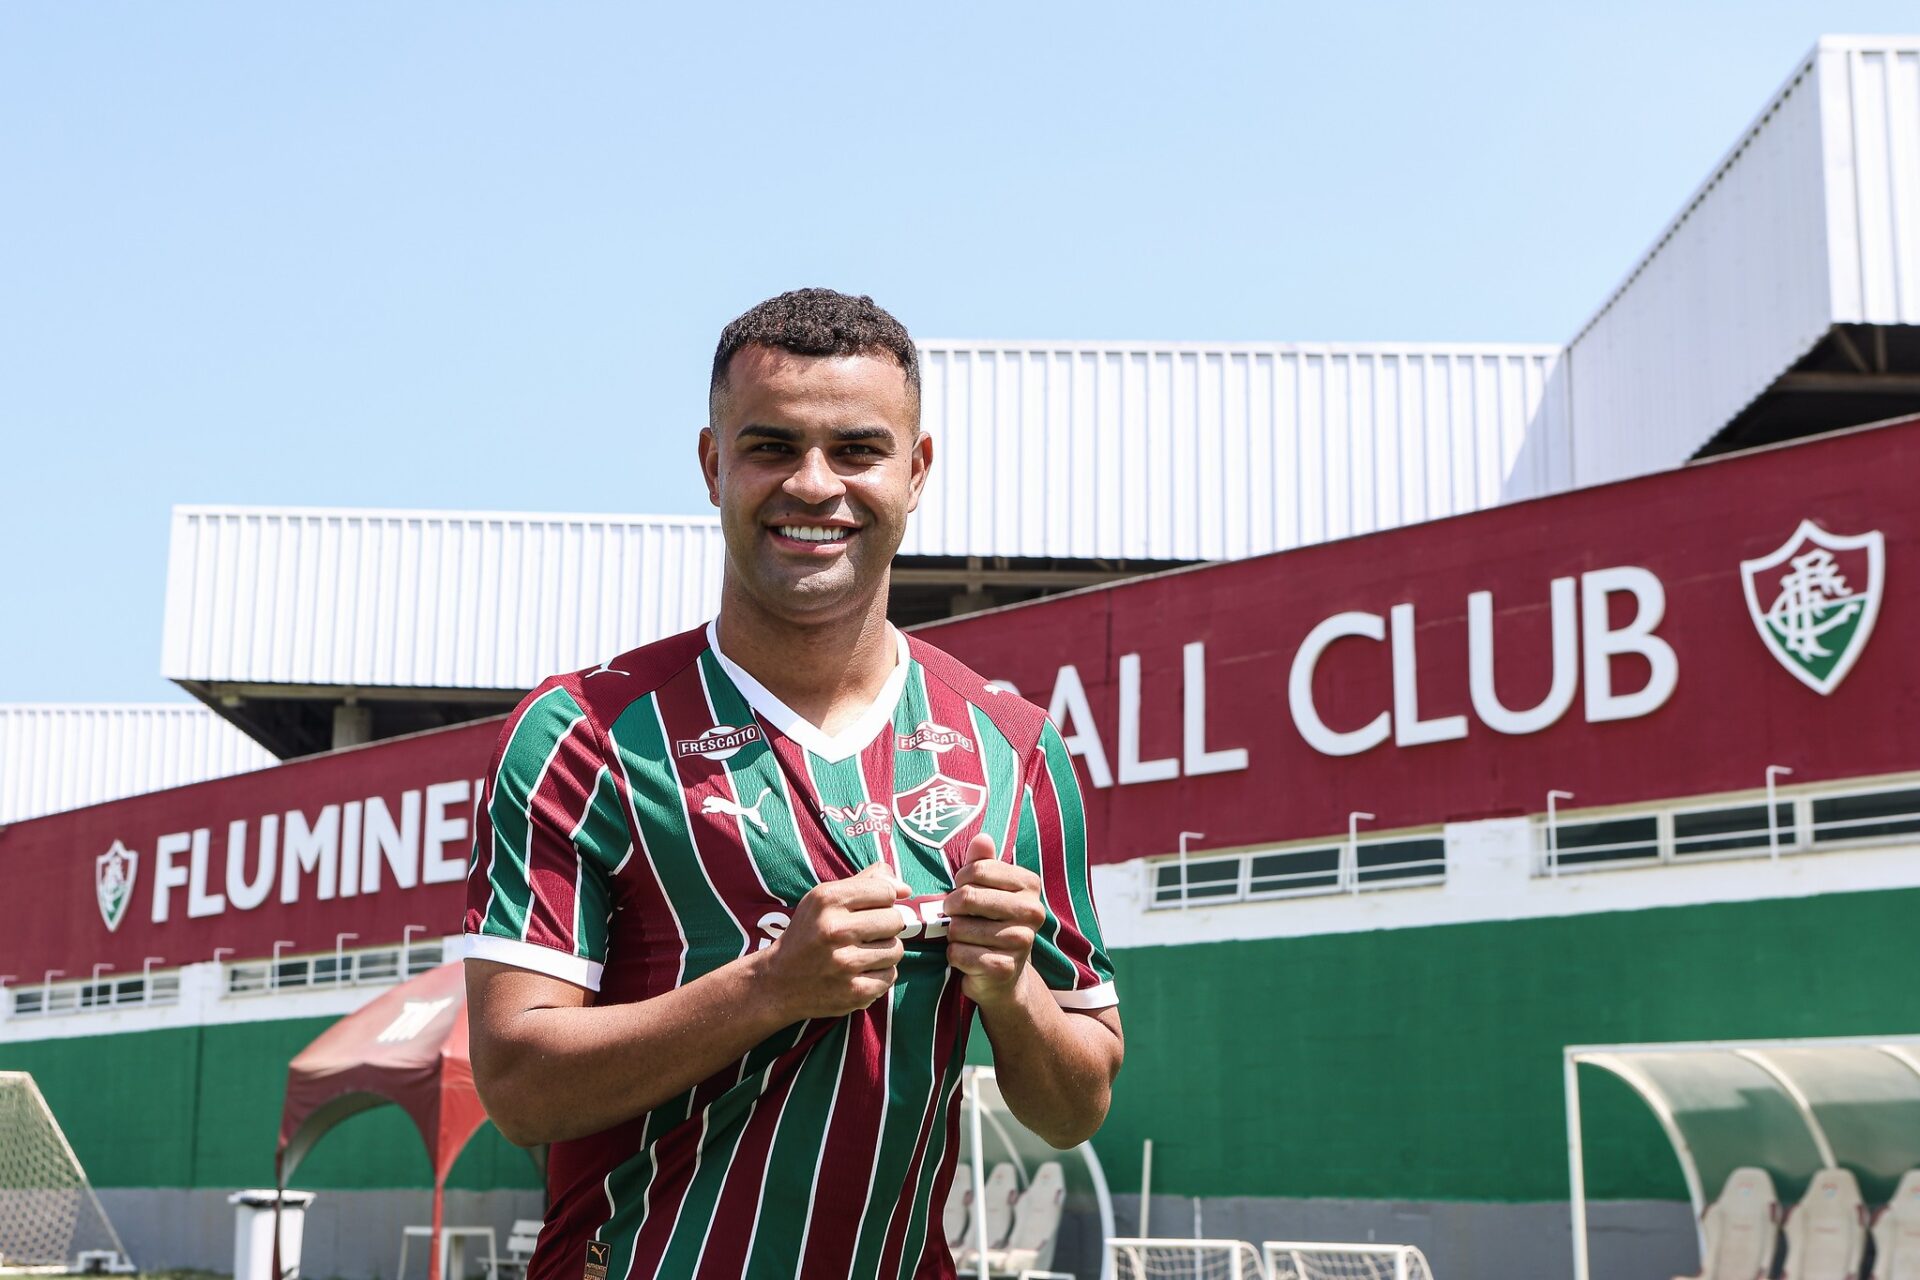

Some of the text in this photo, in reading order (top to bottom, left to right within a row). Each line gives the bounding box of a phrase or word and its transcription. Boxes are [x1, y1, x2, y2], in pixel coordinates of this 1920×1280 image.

[151, 565, 1679, 924] FLUMINE ALL CLUB
[681, 727, 756, 754] FRESCATTO
[900, 730, 970, 750] FRESCATTO
[845, 818, 892, 837] saúde
